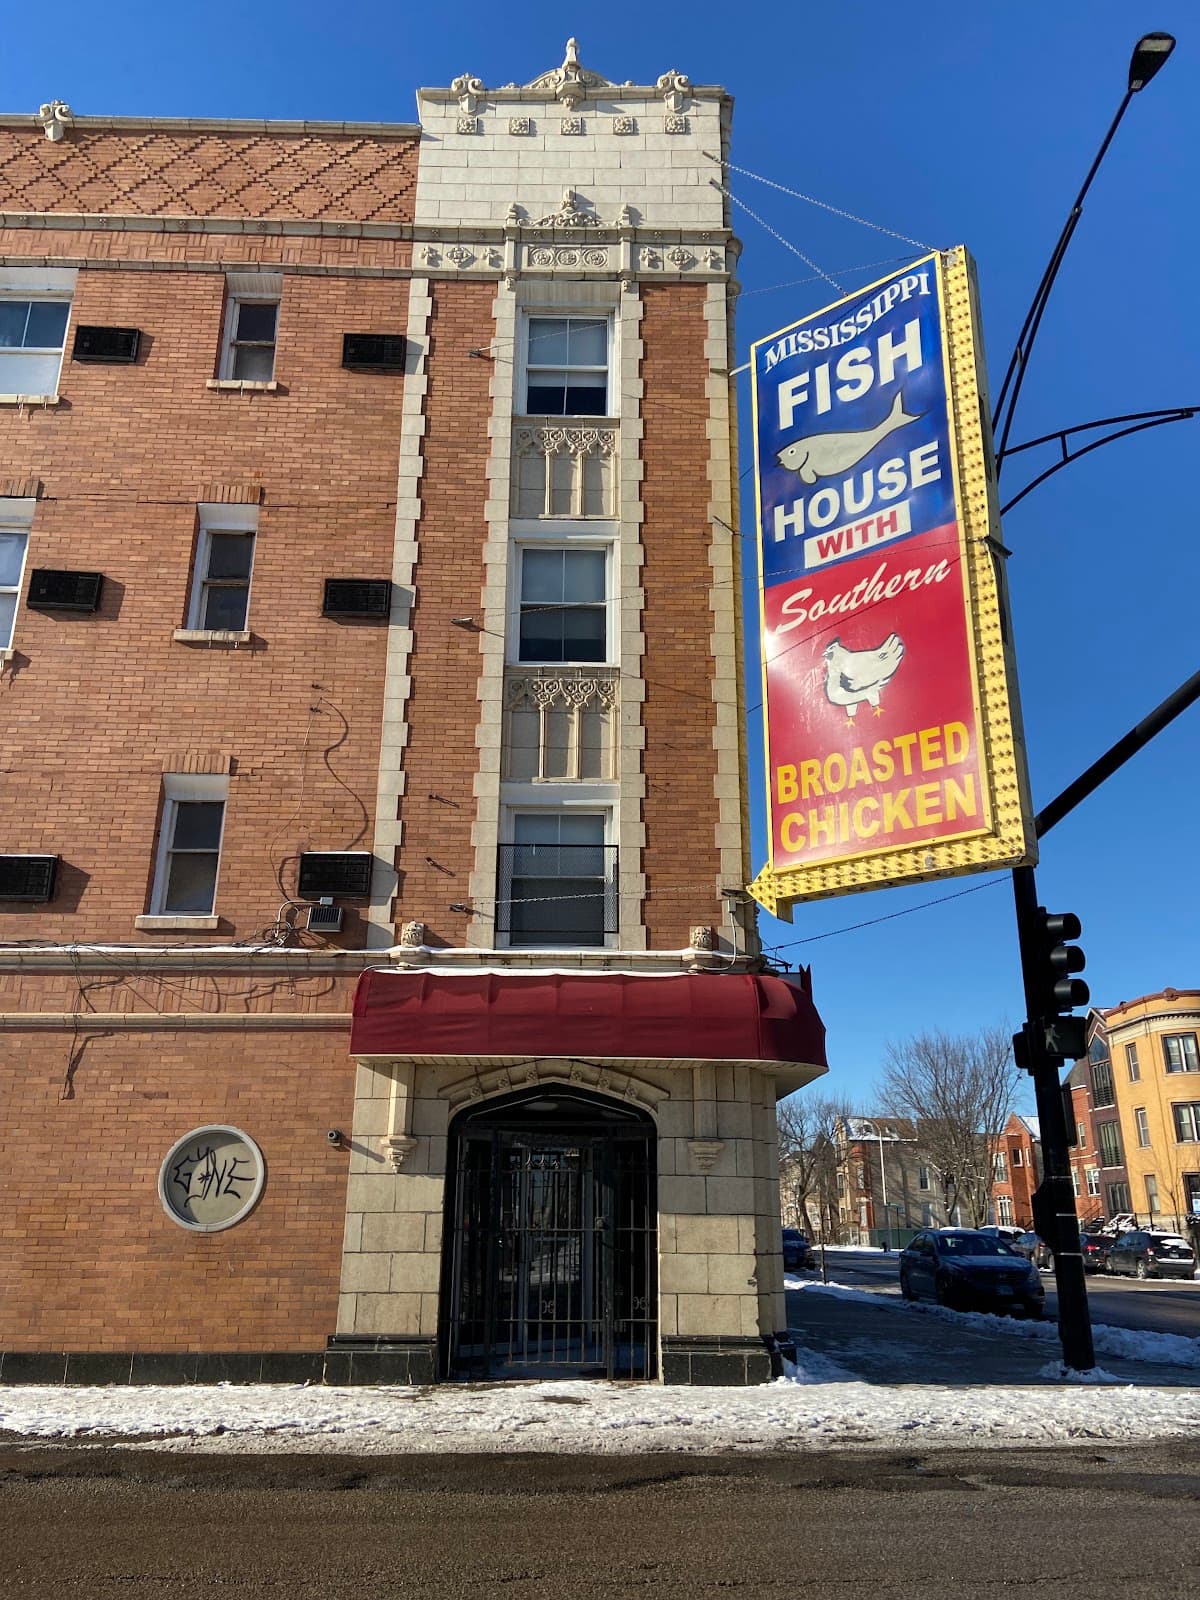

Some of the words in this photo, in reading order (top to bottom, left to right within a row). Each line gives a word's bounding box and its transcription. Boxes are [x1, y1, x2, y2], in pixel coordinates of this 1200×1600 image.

[764, 273, 931, 374] MISSISSIPPI
[778, 317, 923, 431] FISH
[773, 440, 942, 543] HOUSE
[816, 510, 899, 560] WITH
[775, 558, 952, 635] Southern
[777, 721, 970, 804] BROASTED
[780, 774, 977, 853] CHICKEN
